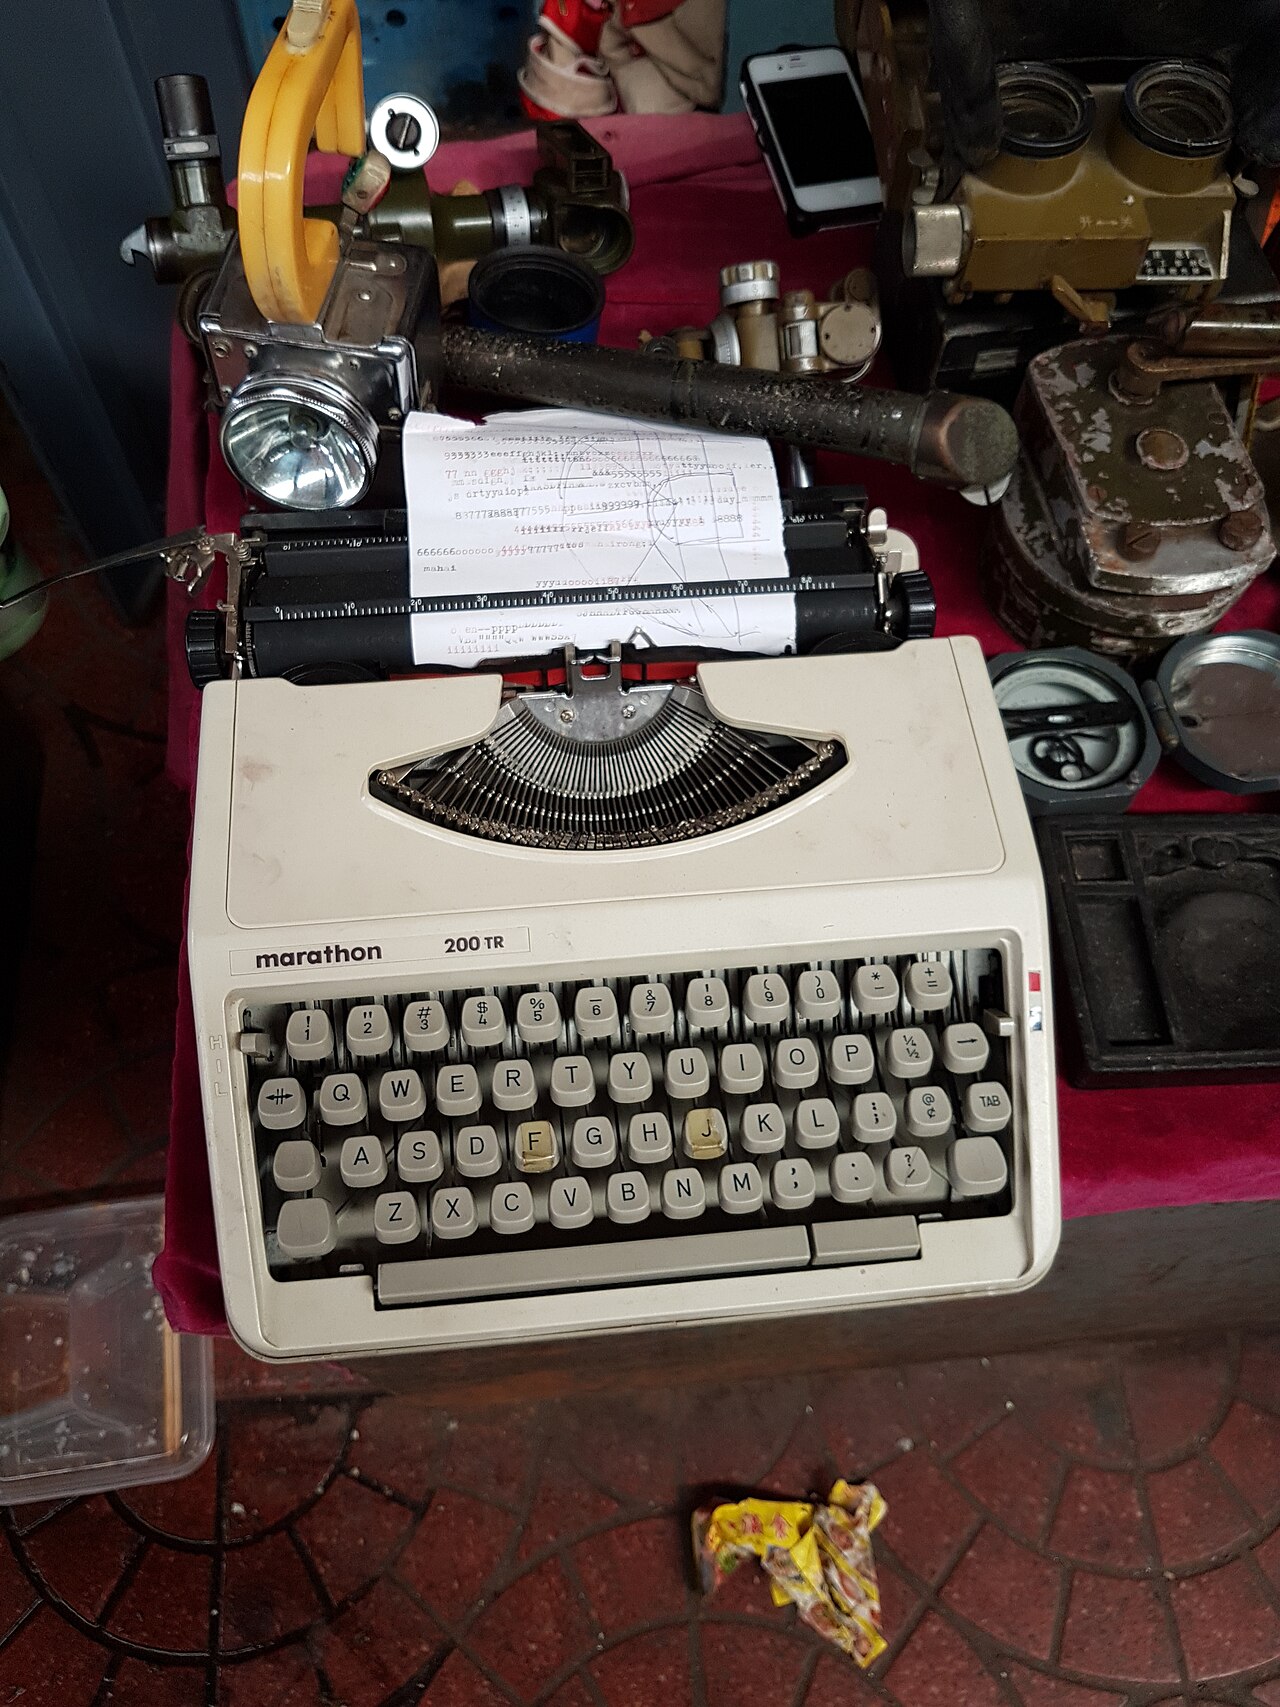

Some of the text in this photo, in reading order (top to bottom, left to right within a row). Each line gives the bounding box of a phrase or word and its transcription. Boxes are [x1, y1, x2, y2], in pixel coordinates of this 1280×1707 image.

[737, 580, 749, 588] 70
[256, 943, 382, 968] marathon
[444, 935, 505, 953] 200 TR
[332, 1083, 351, 1102] Q
[390, 1078, 410, 1099] W
[450, 1074, 465, 1093] E
[506, 1069, 521, 1088] R
[564, 1065, 578, 1084] T
[622, 1061, 636, 1080] Y
[680, 1057, 695, 1076] U
[789, 1048, 805, 1066] O
[845, 1044, 859, 1063] P
[979, 1095, 1001, 1107] TAB
[353, 1109, 825, 1166] A S D F G H J K L
[388, 1172, 751, 1222] Z X C V B N M
